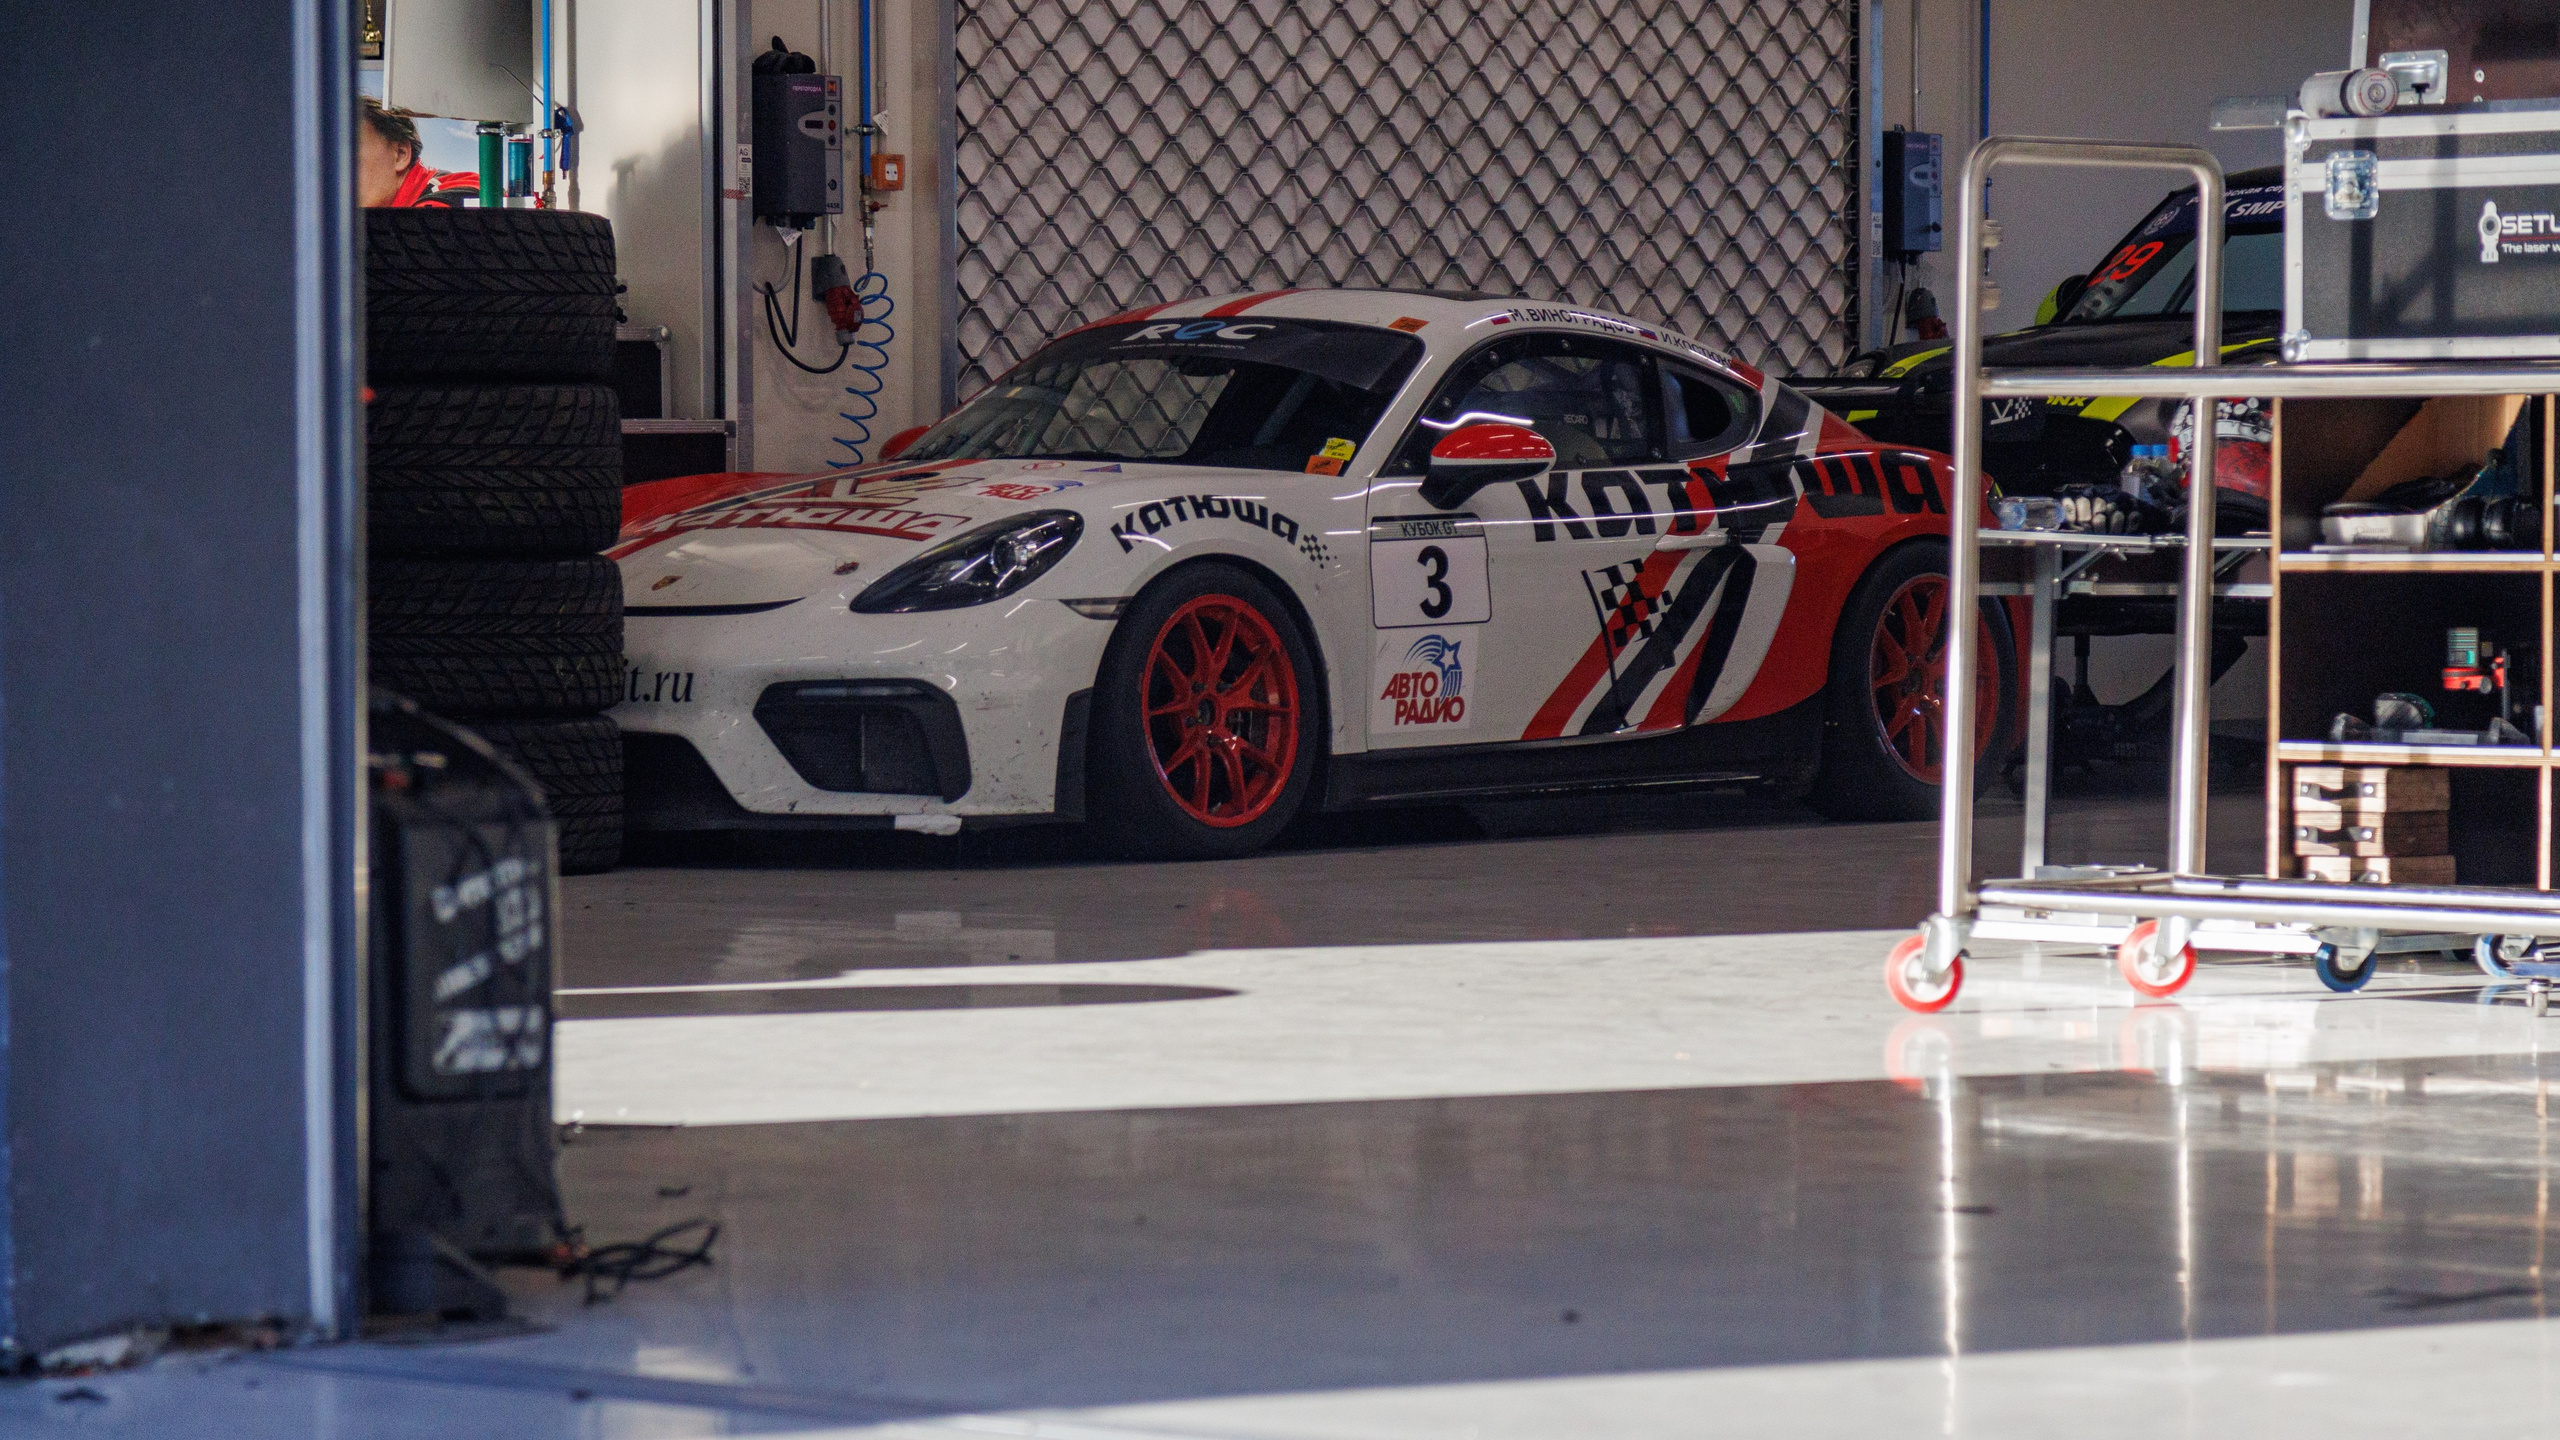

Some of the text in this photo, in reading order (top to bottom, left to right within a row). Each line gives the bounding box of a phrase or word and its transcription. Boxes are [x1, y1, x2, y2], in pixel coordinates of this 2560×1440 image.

[2501, 243, 2523, 254] The
[2524, 242, 2551, 253] laser
[2088, 241, 2164, 288] 29
[1564, 413, 1589, 425] RECARO
[1401, 522, 1442, 537] КУБОК
[1417, 545, 1453, 619] 3
[1380, 671, 1439, 700] АВТО
[1394, 695, 1465, 726] РАДИО
